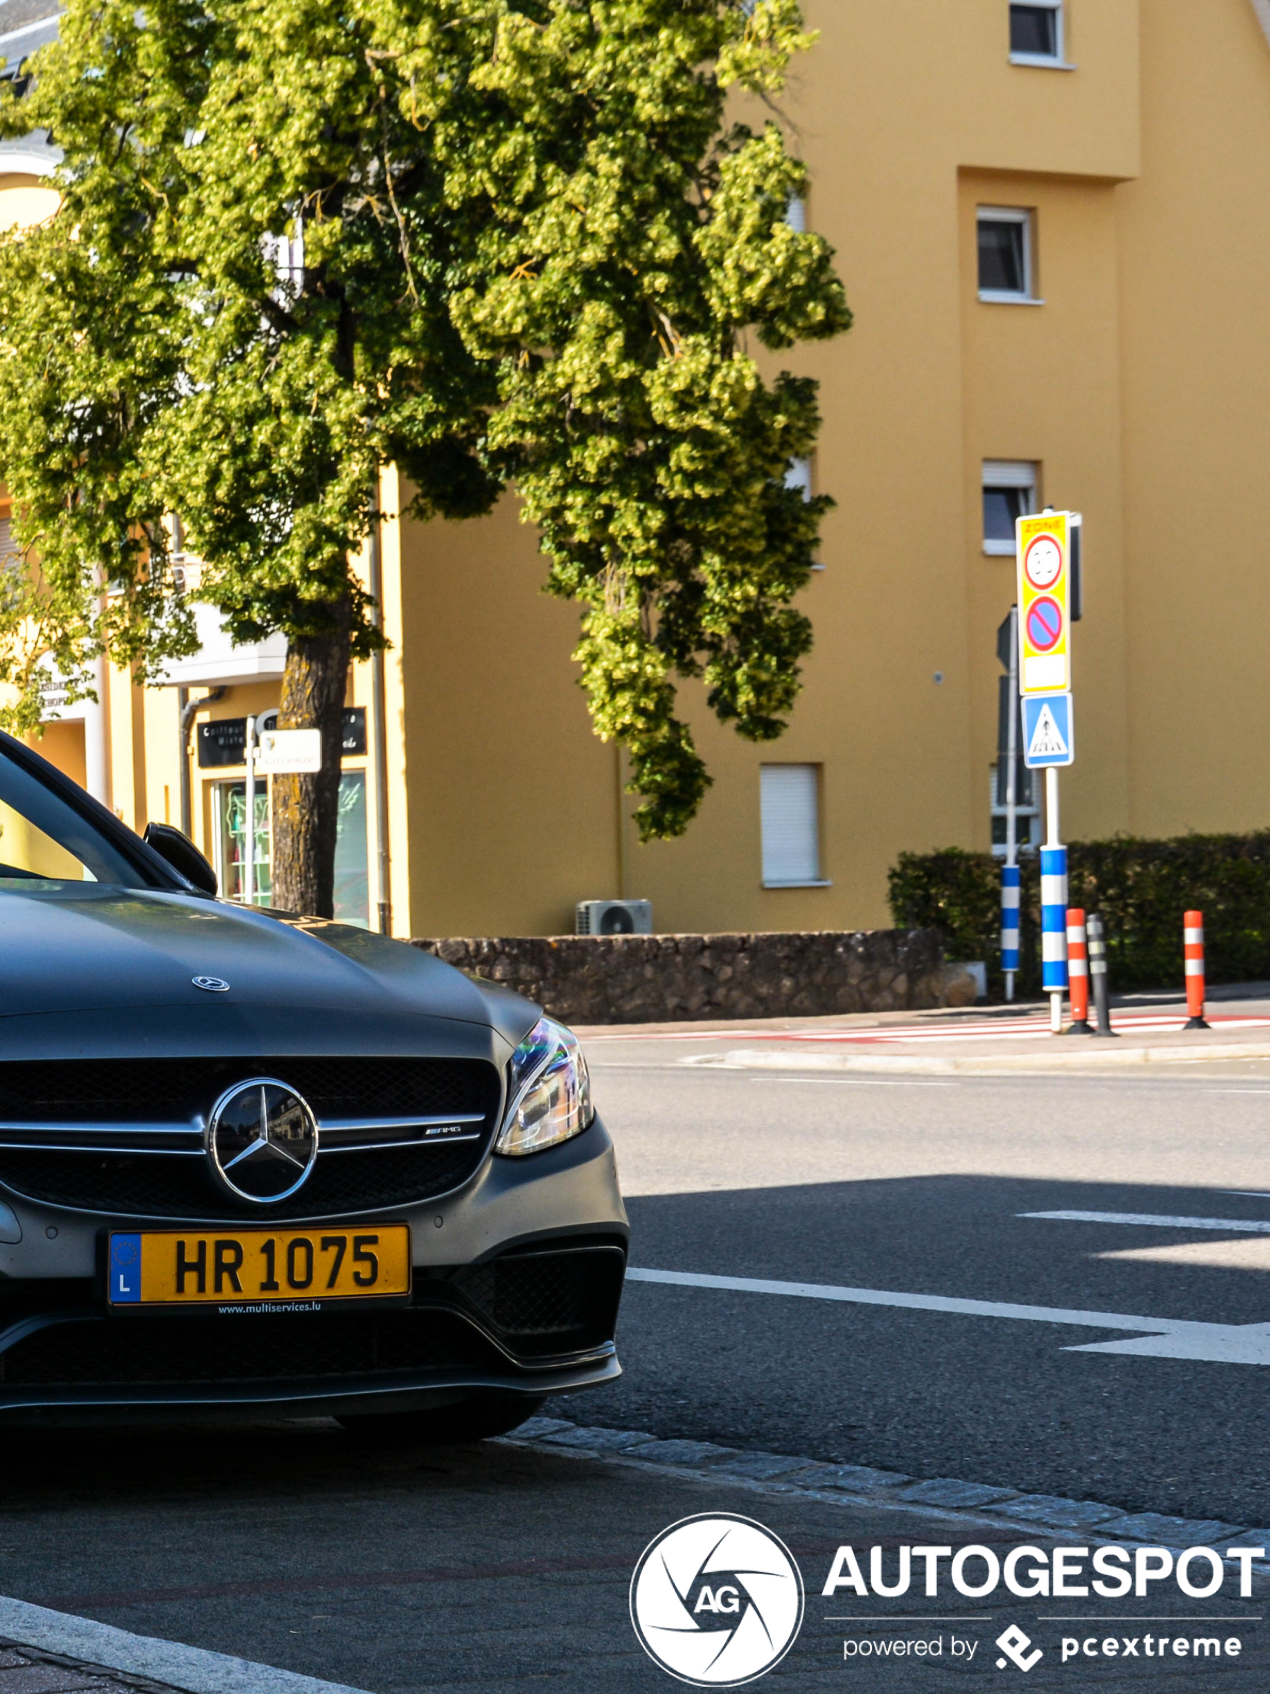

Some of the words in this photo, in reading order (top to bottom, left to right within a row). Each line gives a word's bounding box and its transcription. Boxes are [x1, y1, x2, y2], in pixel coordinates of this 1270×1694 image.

[1025, 519, 1061, 533] ZONE
[218, 736, 244, 746] Mixte
[436, 1126, 461, 1134] AMG
[119, 1274, 130, 1292] L
[218, 1301, 321, 1314] www.multiservices.lu
